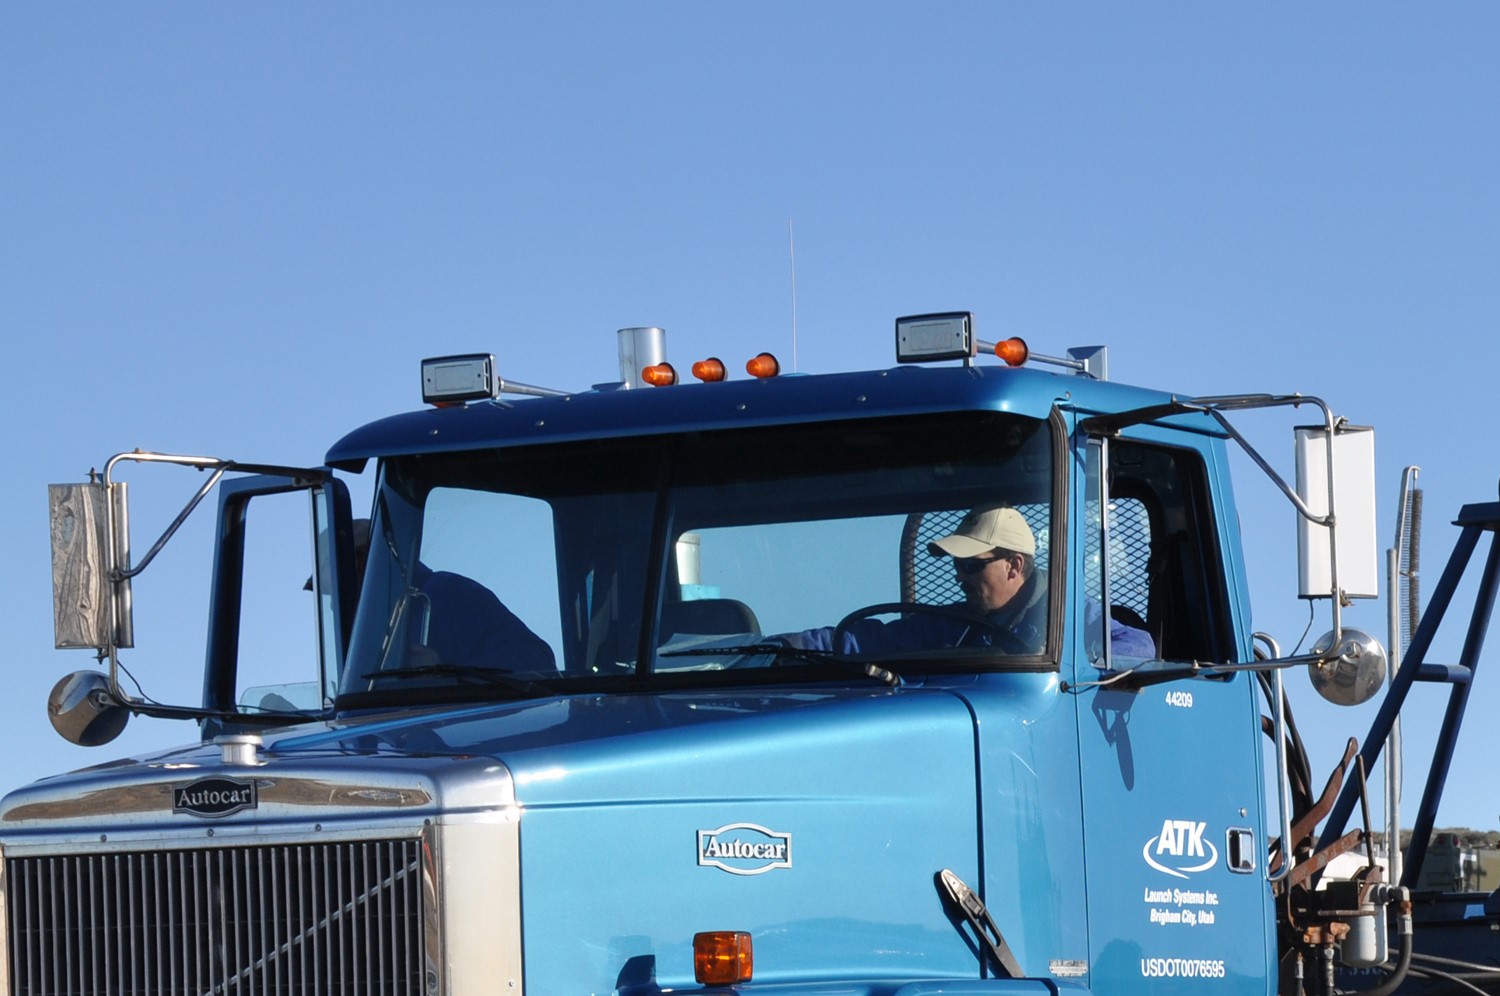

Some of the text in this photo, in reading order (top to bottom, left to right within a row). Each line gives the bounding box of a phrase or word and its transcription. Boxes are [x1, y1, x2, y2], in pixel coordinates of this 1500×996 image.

[1165, 691, 1193, 708] 44209
[177, 789, 250, 807] Autocar
[704, 835, 786, 859] Autocar
[1156, 819, 1206, 857] ATK
[1144, 887, 1219, 907] Launch Systems Inc.
[1150, 908, 1215, 927] Brigham City, Utah
[1141, 958, 1225, 978] USDOT0076595
